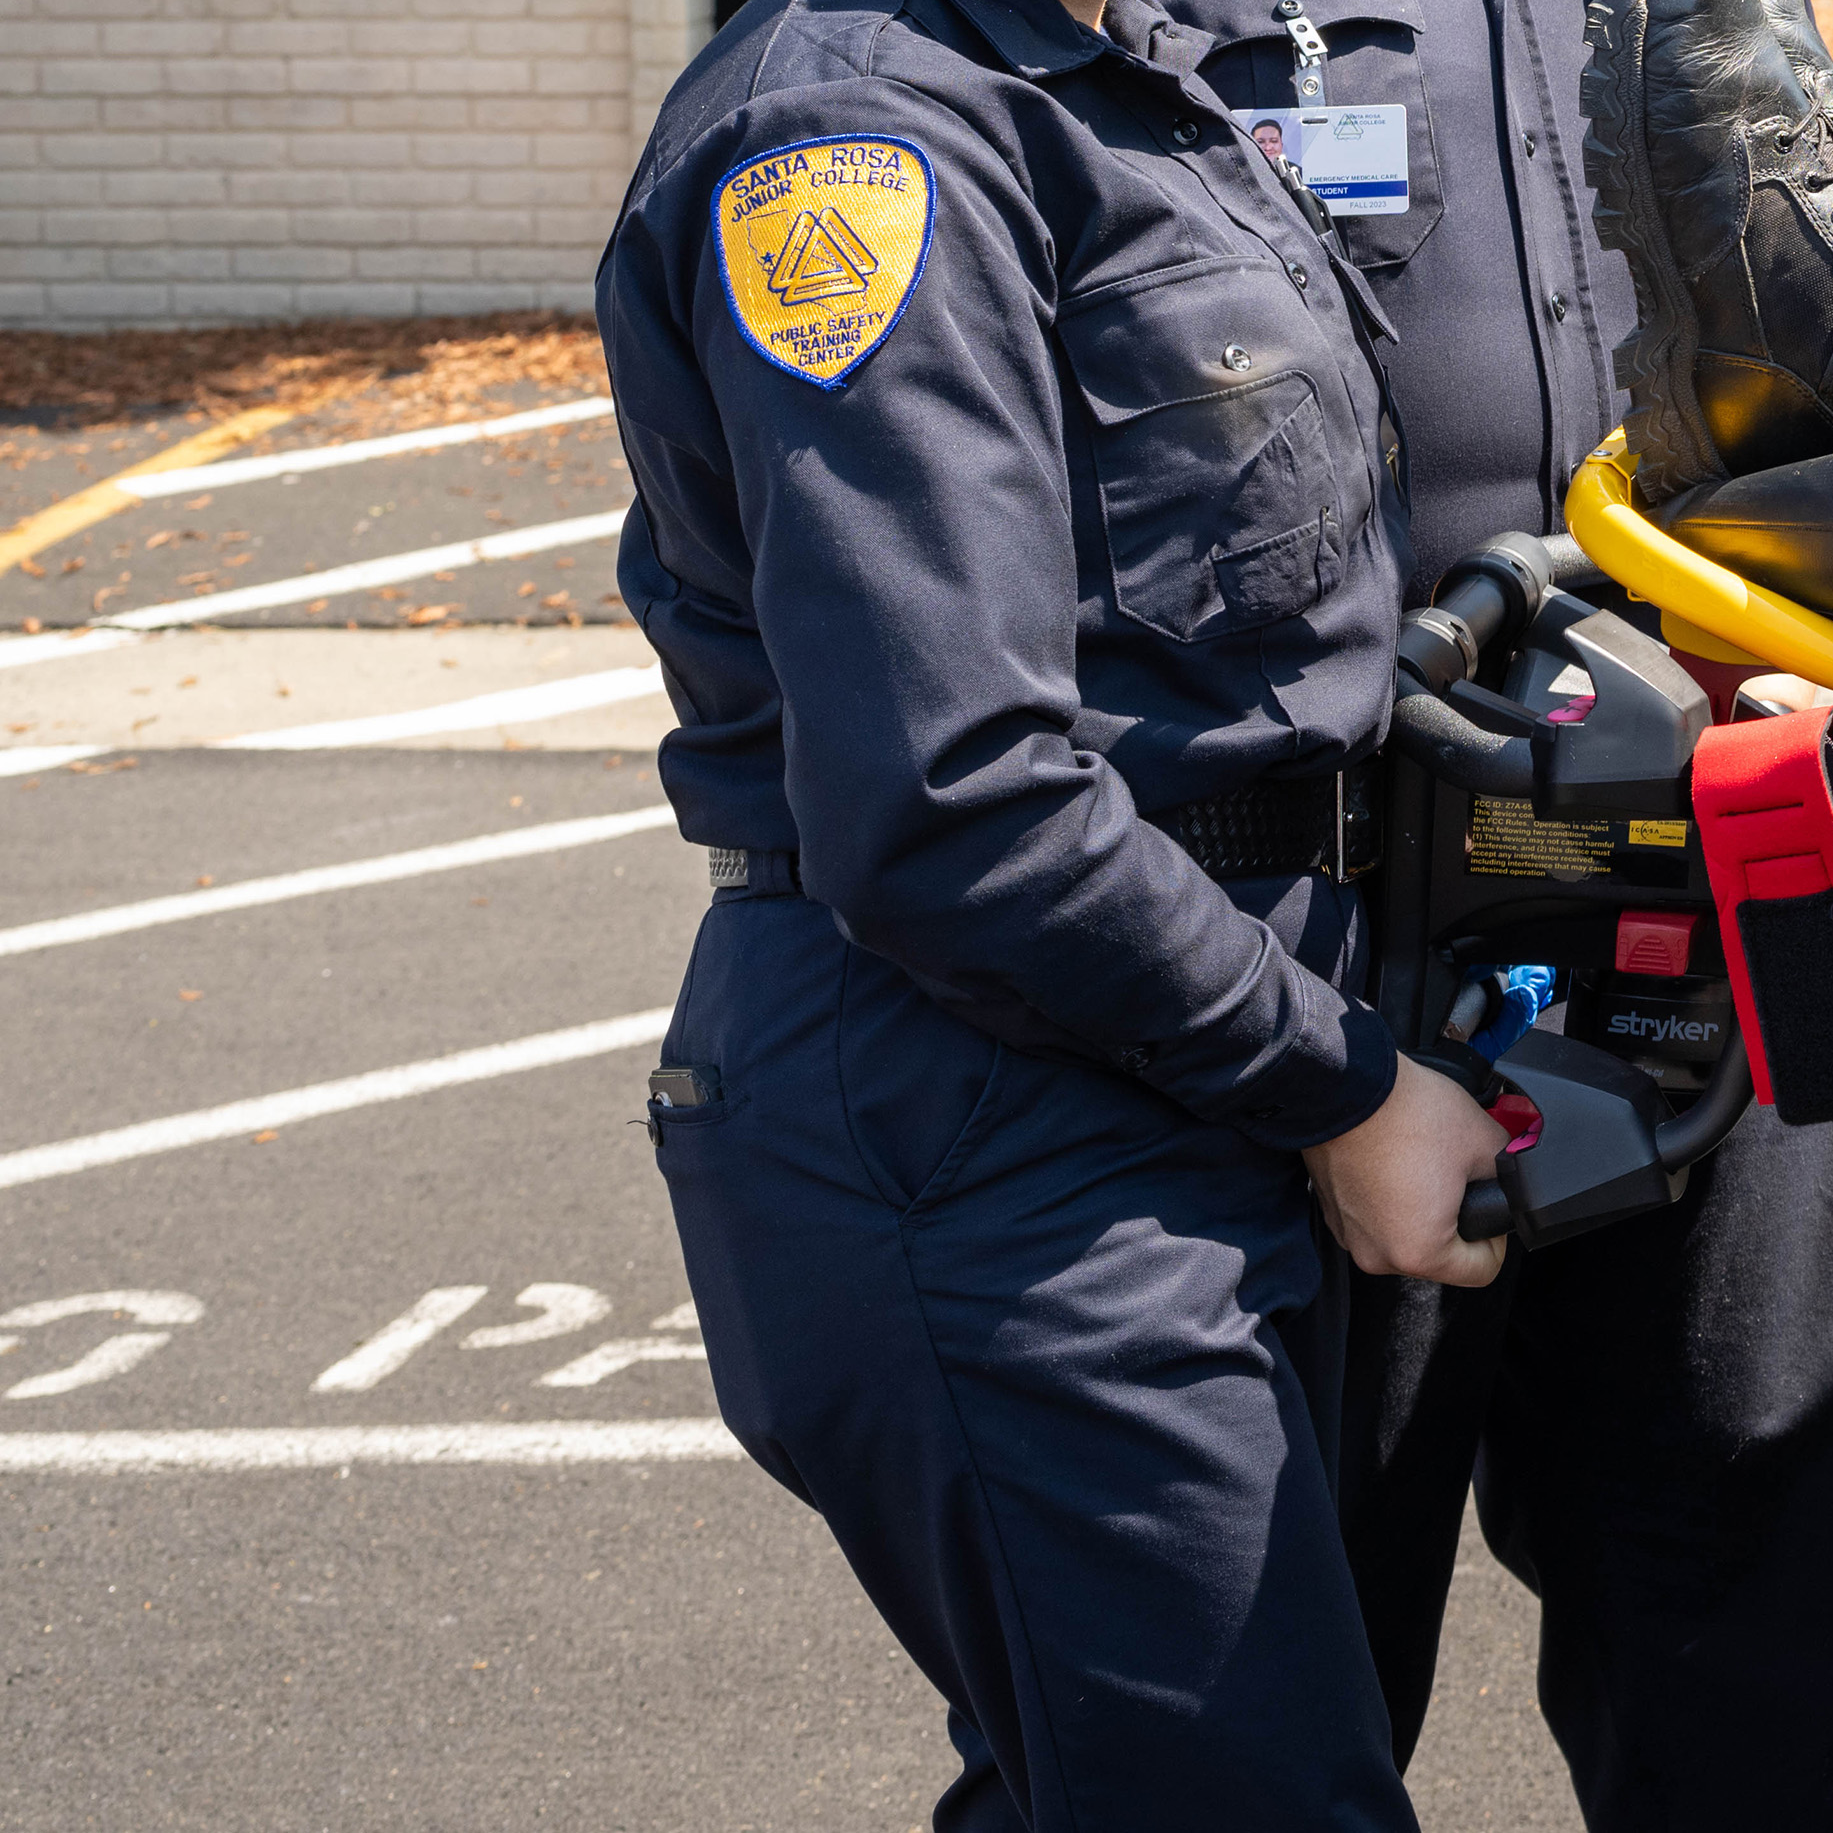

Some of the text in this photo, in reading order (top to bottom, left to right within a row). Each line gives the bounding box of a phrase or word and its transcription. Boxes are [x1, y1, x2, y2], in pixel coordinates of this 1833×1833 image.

[731, 146, 901, 199] SANTA ROSA
[731, 171, 909, 222] JUNIOR COLLEGE
[1312, 187, 1348, 195] STUDENT
[770, 312, 886, 345] PUBLIC SAFETY
[792, 330, 862, 353] TRAINING
[798, 346, 855, 367] CENTER
[1474, 808, 1490, 816] This
[1496, 827, 1531, 836] following
[1506, 818, 1529, 826] Rules.
[1534, 820, 1570, 829] Operation
[1572, 821, 1579, 829] is
[1581, 824, 1609, 832] subject
[1473, 842, 1519, 851] interference,
[1471, 858, 1506, 867] including
[1508, 860, 1552, 868] interference
[1514, 853, 1559, 861] interference
[1561, 856, 1595, 864] received,
[1608, 1010, 1719, 1041] stryker
